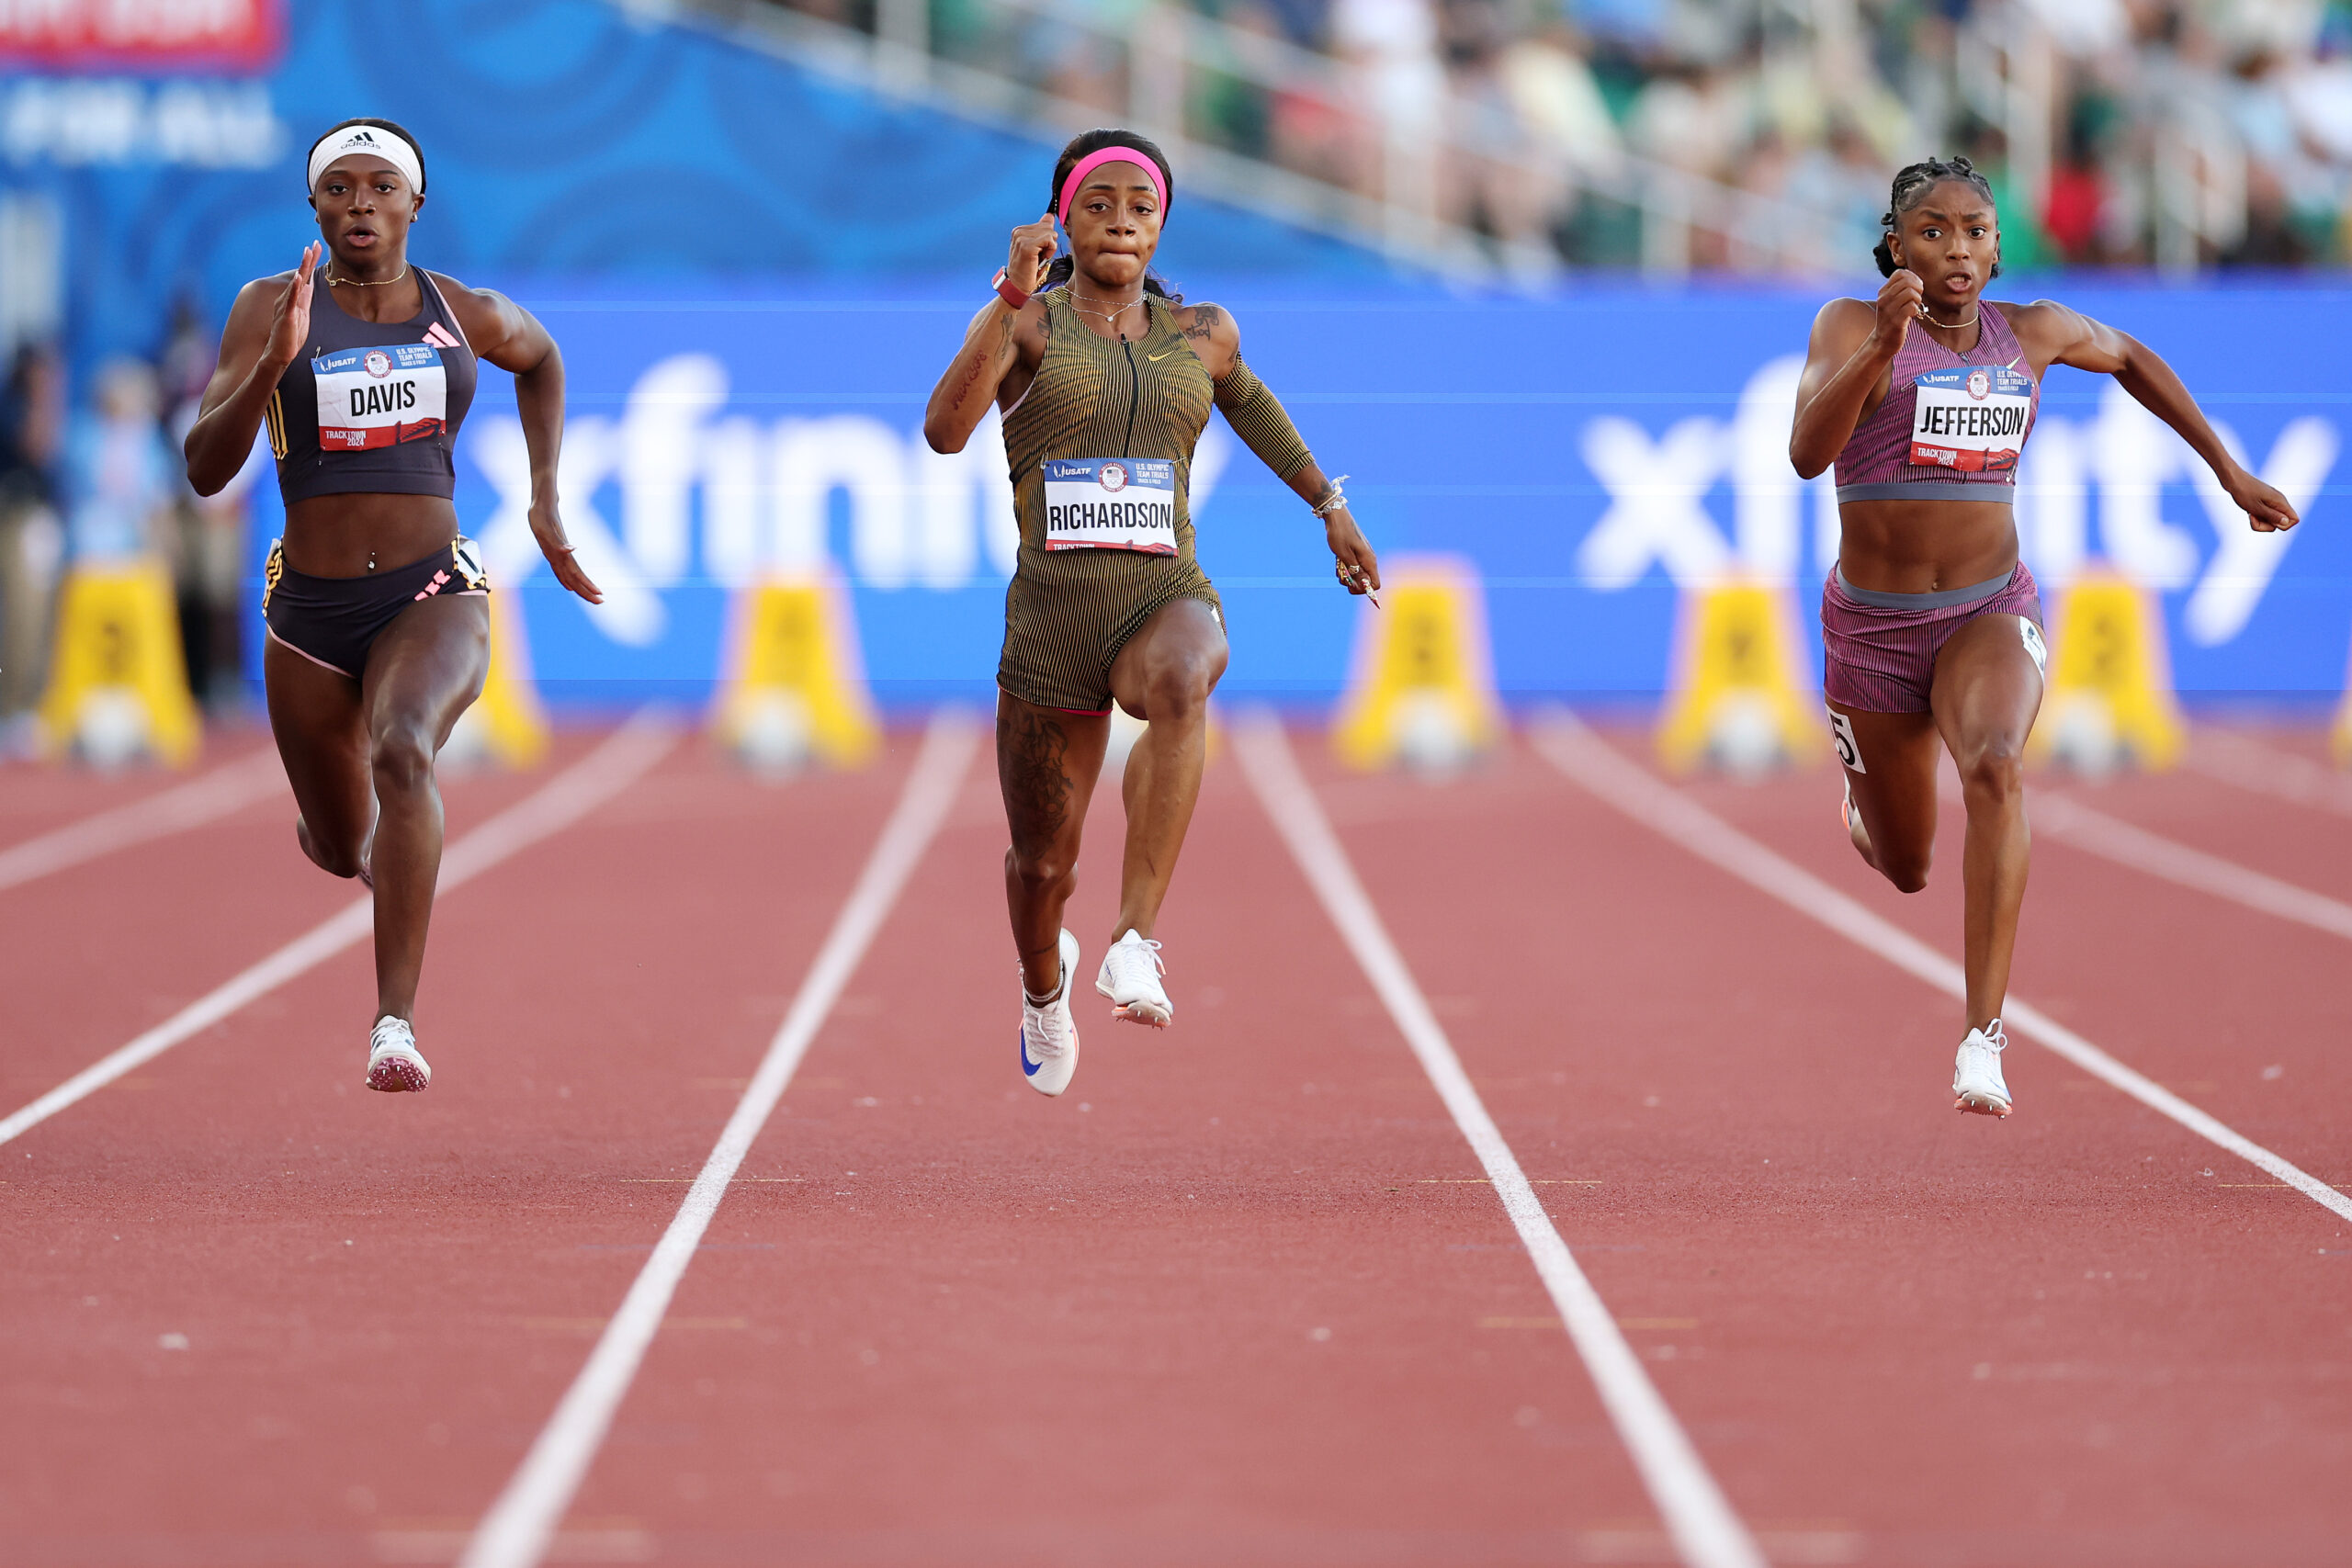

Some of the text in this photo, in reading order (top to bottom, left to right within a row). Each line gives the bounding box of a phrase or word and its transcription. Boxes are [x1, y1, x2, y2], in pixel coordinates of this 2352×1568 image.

[340, 140, 381, 150] adidas
[331, 356, 357, 368] USATF
[398, 352, 433, 362] TEAM TRIALS
[1996, 378, 2028, 387] TEAM TRIALS
[350, 380, 416, 417] DAVIS
[1920, 406, 2025, 436] JEFFERSON
[325, 430, 367, 440] TRACKTOWN
[346, 438, 365, 447] 2024
[1917, 447, 1958, 459] TRACKTOWN
[1937, 457, 1954, 466] 2024
[1065, 467, 1092, 476] USATF
[1147, 463, 1170, 471] OLYMPIC
[1136, 470, 1170, 479] TEAM TRIALS
[1049, 502, 1171, 532] RICHARDSON
[1829, 713, 1856, 766] 5
